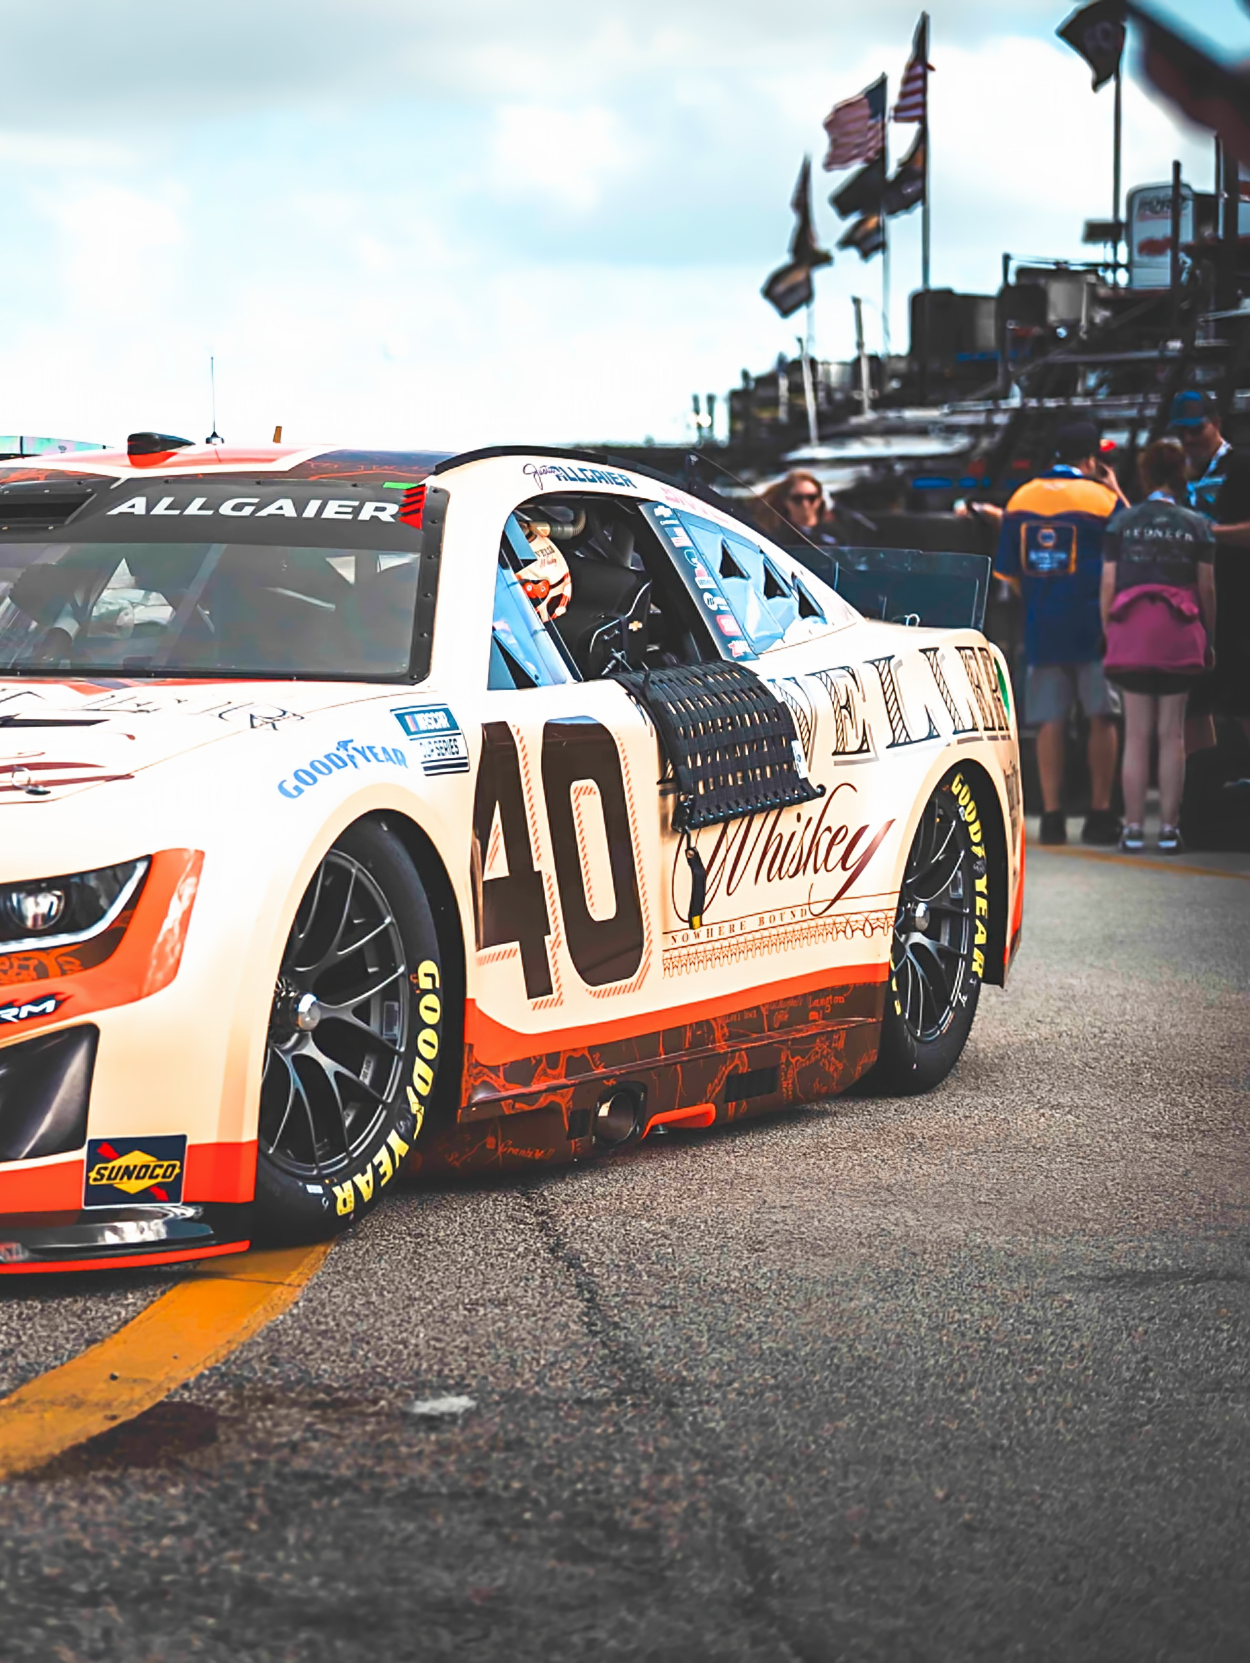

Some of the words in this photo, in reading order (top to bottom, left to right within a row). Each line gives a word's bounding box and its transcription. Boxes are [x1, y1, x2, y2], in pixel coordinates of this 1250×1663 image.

[107, 496, 400, 523] ALLGAIER
[413, 710, 451, 731] NASCAR
[434, 738, 460, 757] SERIES
[277, 738, 409, 799] GOODYEAR
[475, 715, 646, 1000] 40
[672, 782, 897, 923] Whiskey
[671, 917, 747, 946] NOWHERE
[758, 908, 809, 926] BOUND
[332, 960, 441, 1217] GOODYEAR
[92, 1163, 178, 1182] SUNOCO
